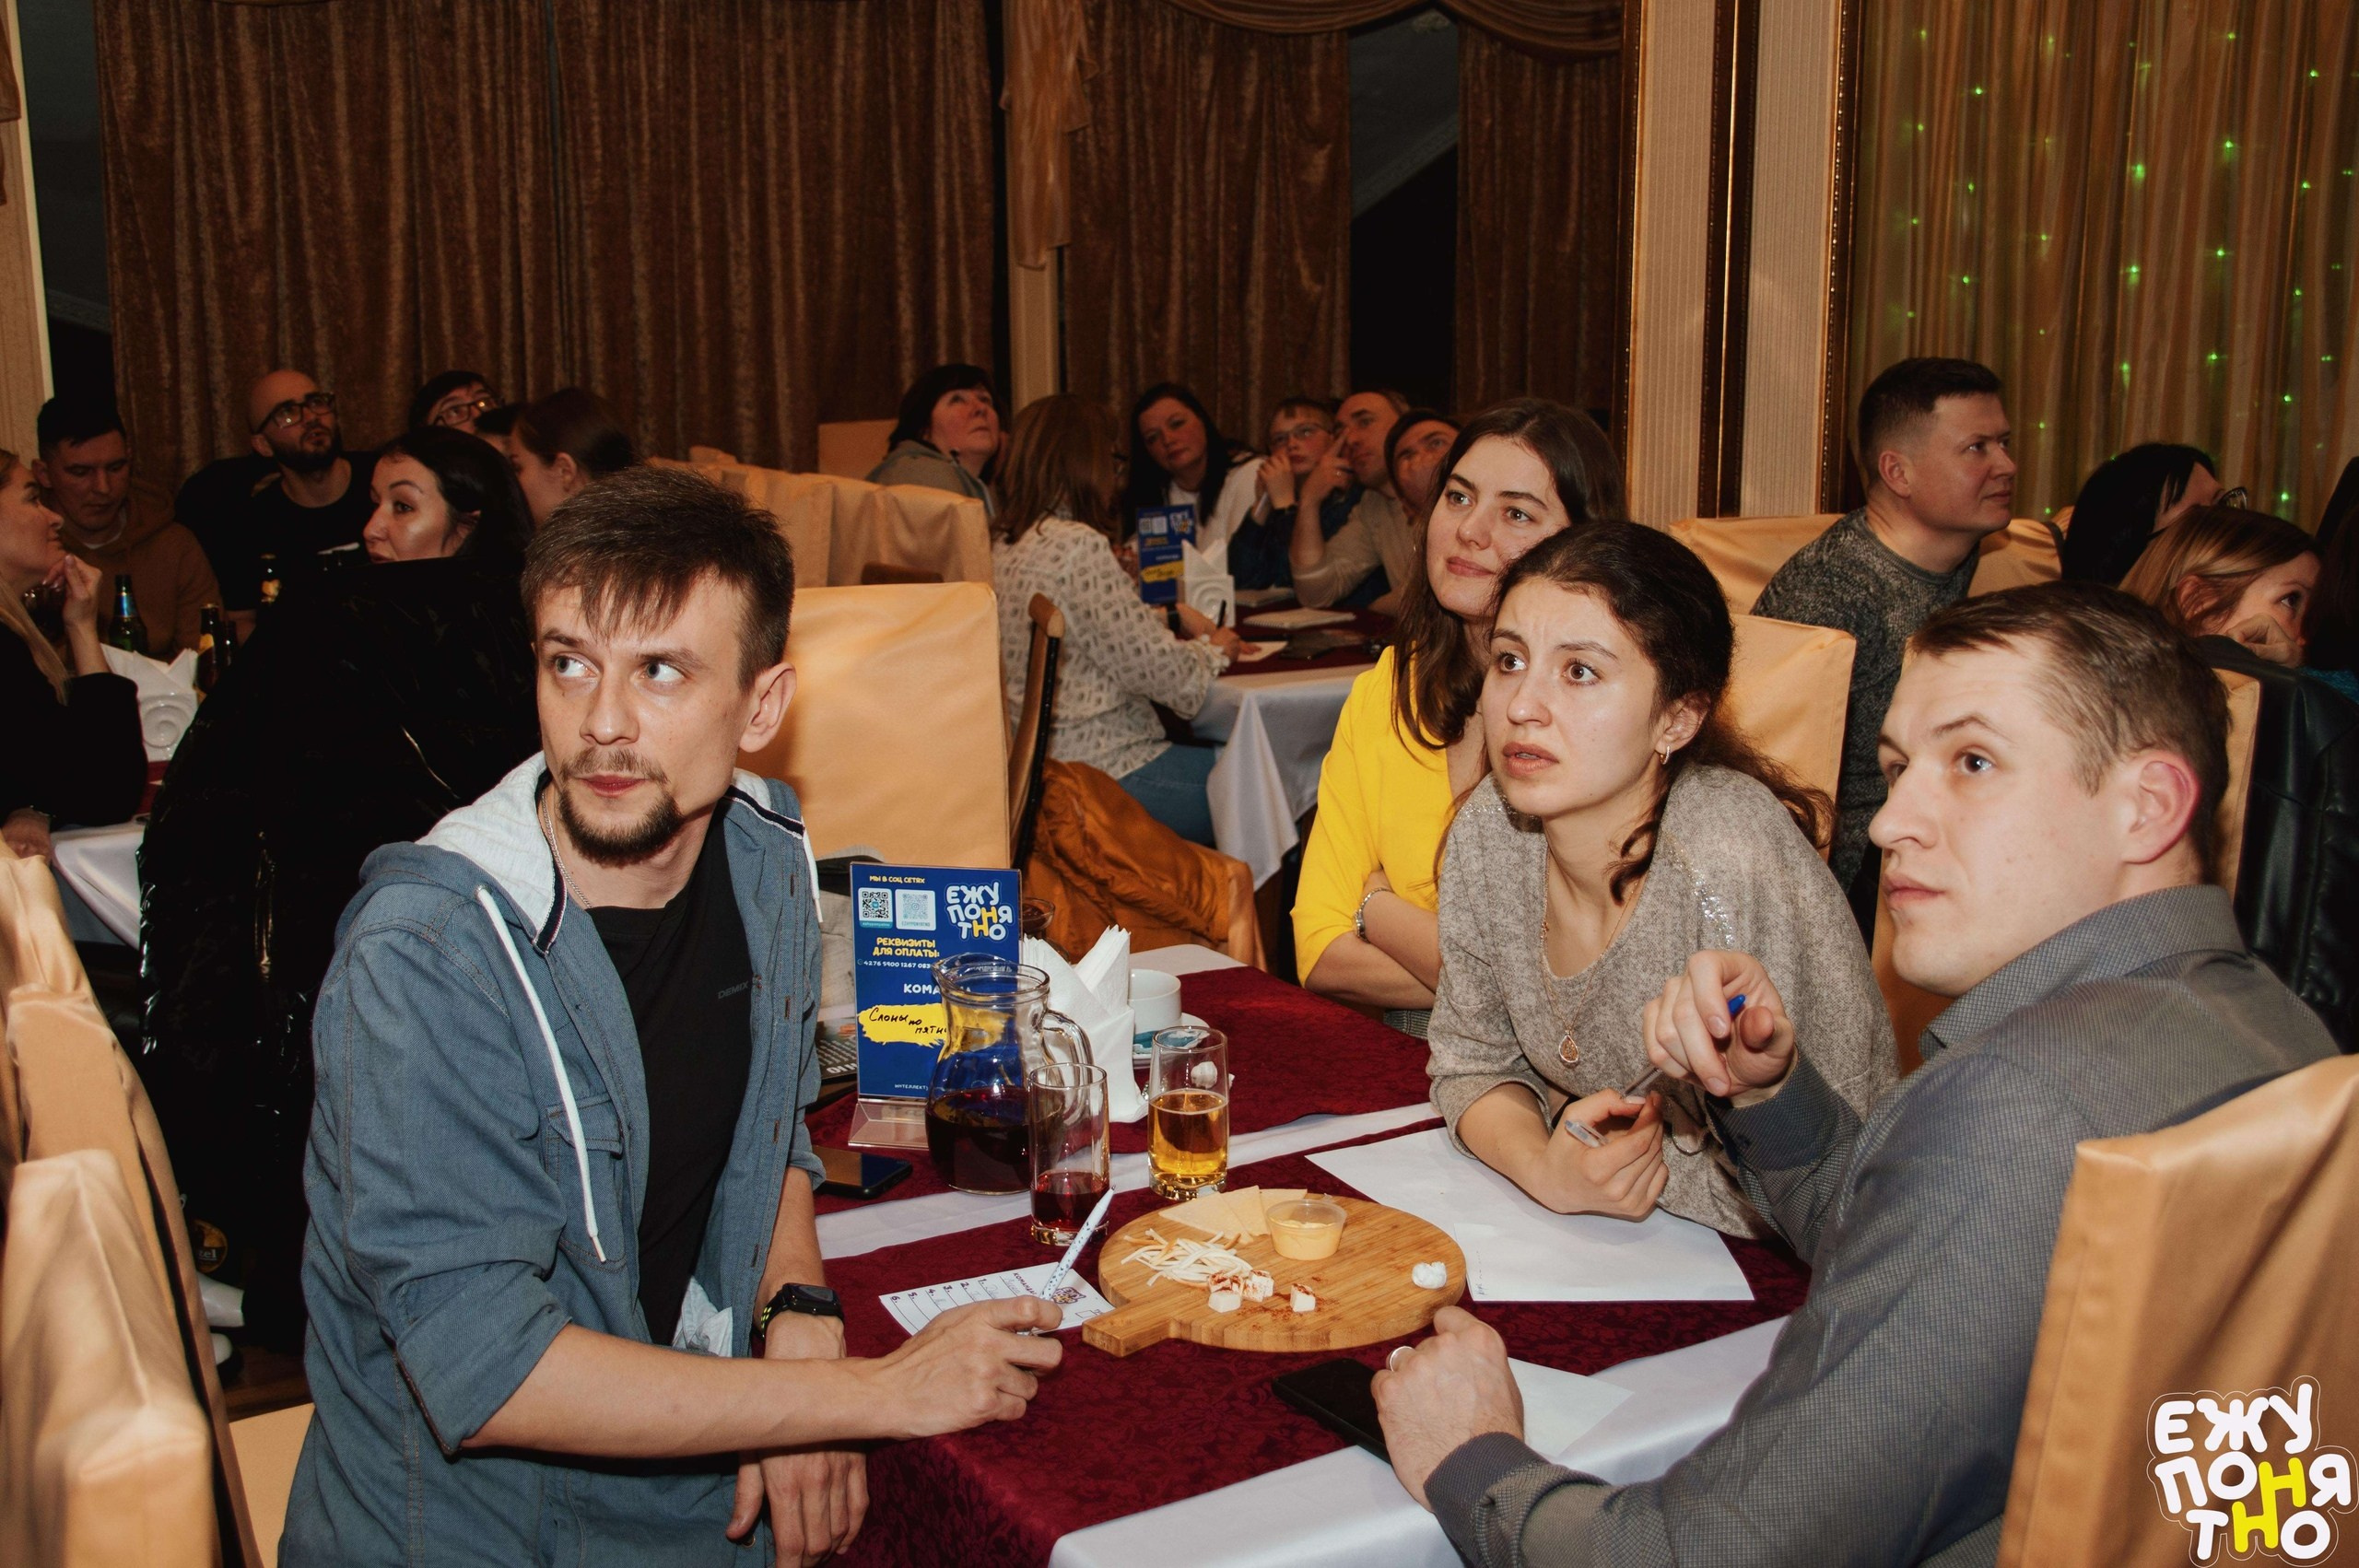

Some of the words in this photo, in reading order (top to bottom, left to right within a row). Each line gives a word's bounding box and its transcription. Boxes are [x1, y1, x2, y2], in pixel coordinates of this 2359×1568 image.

[946, 882, 1000, 906] ЕЖУ
[946, 904, 1013, 924] ПОНЯ
[957, 920, 1006, 941] ТНО
[876, 937, 935, 948] РЕКВИЗИТЫ
[873, 947, 893, 956] ДЛЯ
[895, 948, 940, 958] ОПЛАТЫ:
[718, 980, 748, 999] DEMIX
[869, 1007, 909, 1022] Слоны
